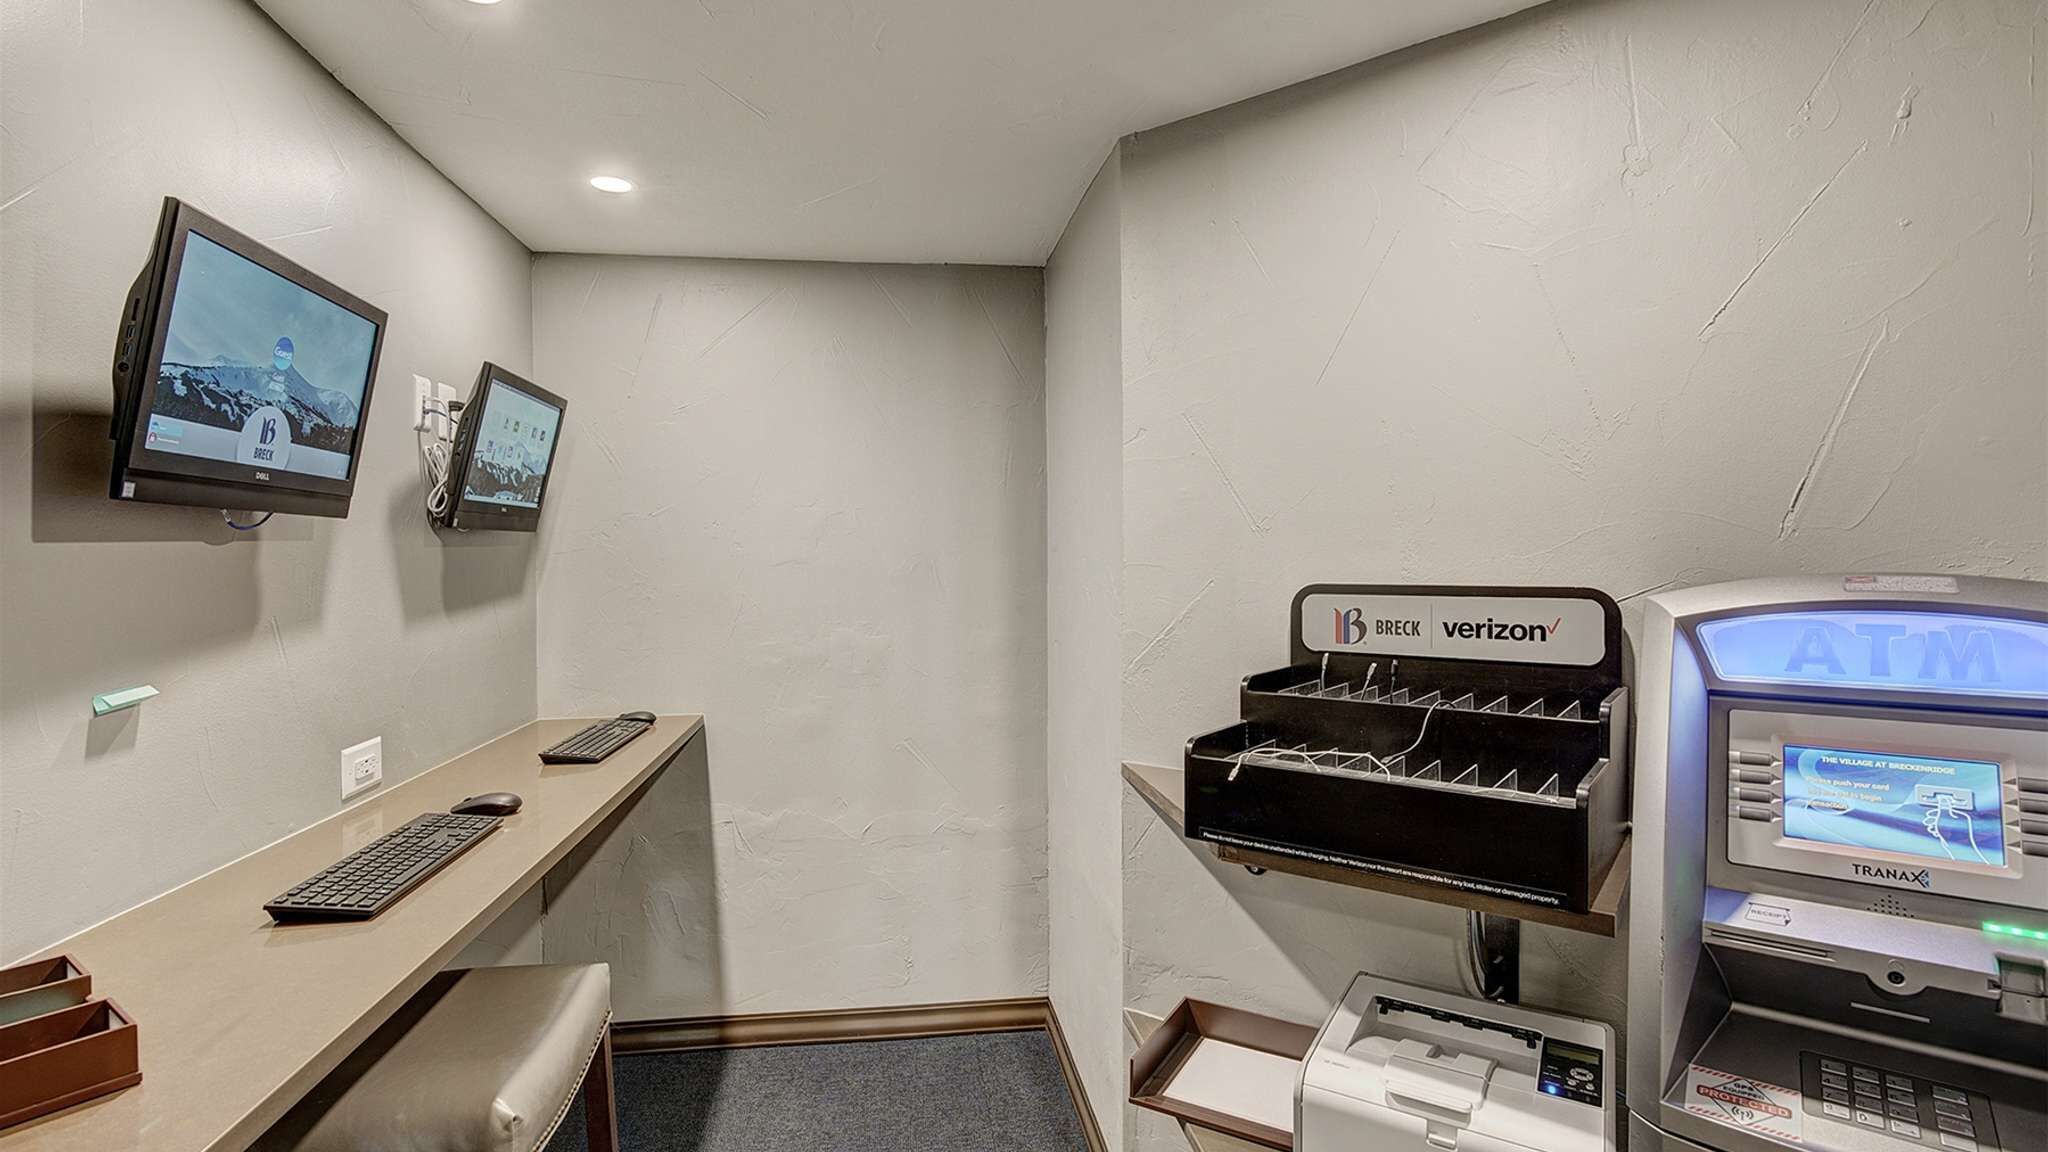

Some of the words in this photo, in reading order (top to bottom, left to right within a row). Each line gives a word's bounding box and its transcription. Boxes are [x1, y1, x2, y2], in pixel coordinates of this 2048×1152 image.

[253, 447, 274, 461] BRECK
[255, 471, 270, 481] DELL
[1375, 619, 1421, 637] BRECK
[1442, 618, 1548, 642] verizon
[1784, 622, 2002, 682] ATM
[1822, 756, 1838, 764] THE
[1840, 758, 1873, 768] VILLAGE
[1875, 761, 1888, 769] AT
[1852, 863, 1928, 888] TRANAX
[1699, 1087, 1789, 1116] PROTECTED
